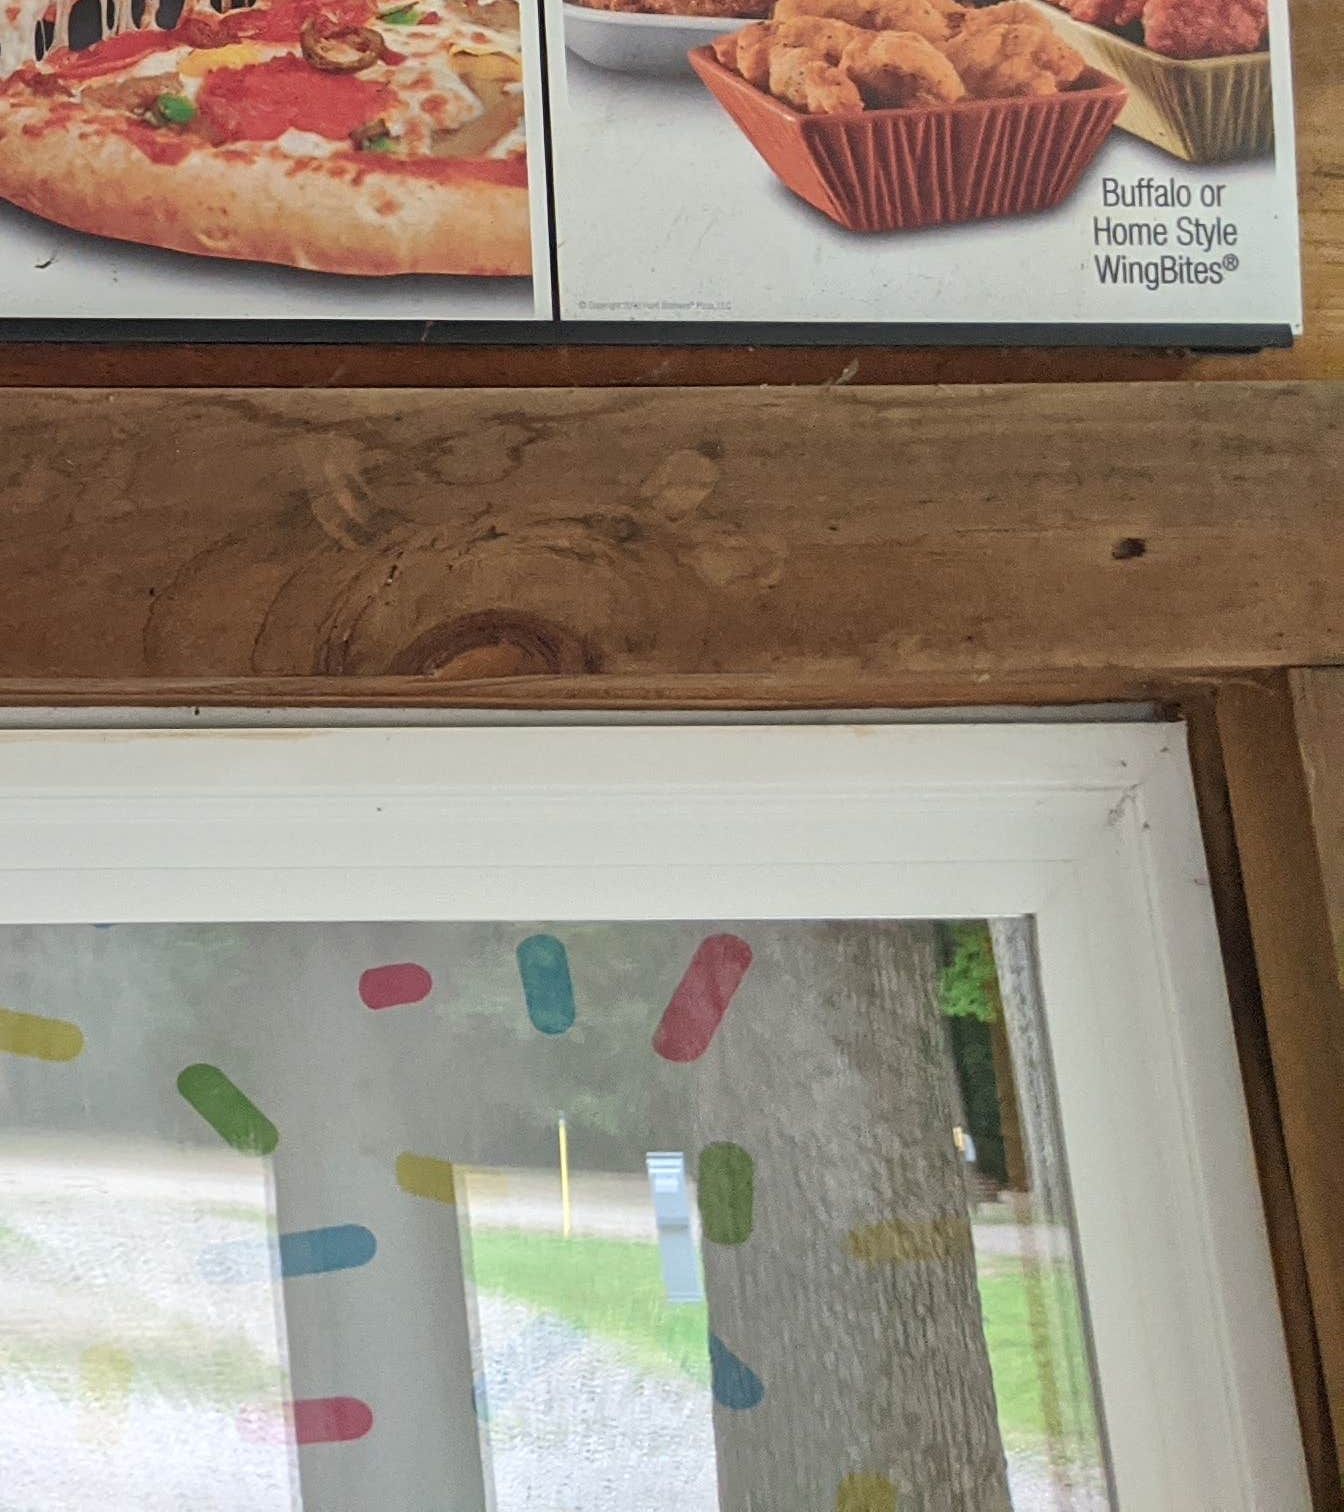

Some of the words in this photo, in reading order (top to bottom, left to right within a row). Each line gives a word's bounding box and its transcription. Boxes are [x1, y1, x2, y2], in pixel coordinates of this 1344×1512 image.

[1102, 178, 1191, 207] Buffalo
[1201, 184, 1226, 207] or
[1094, 216, 1167, 246] Home
[1177, 216, 1237, 253] Style
